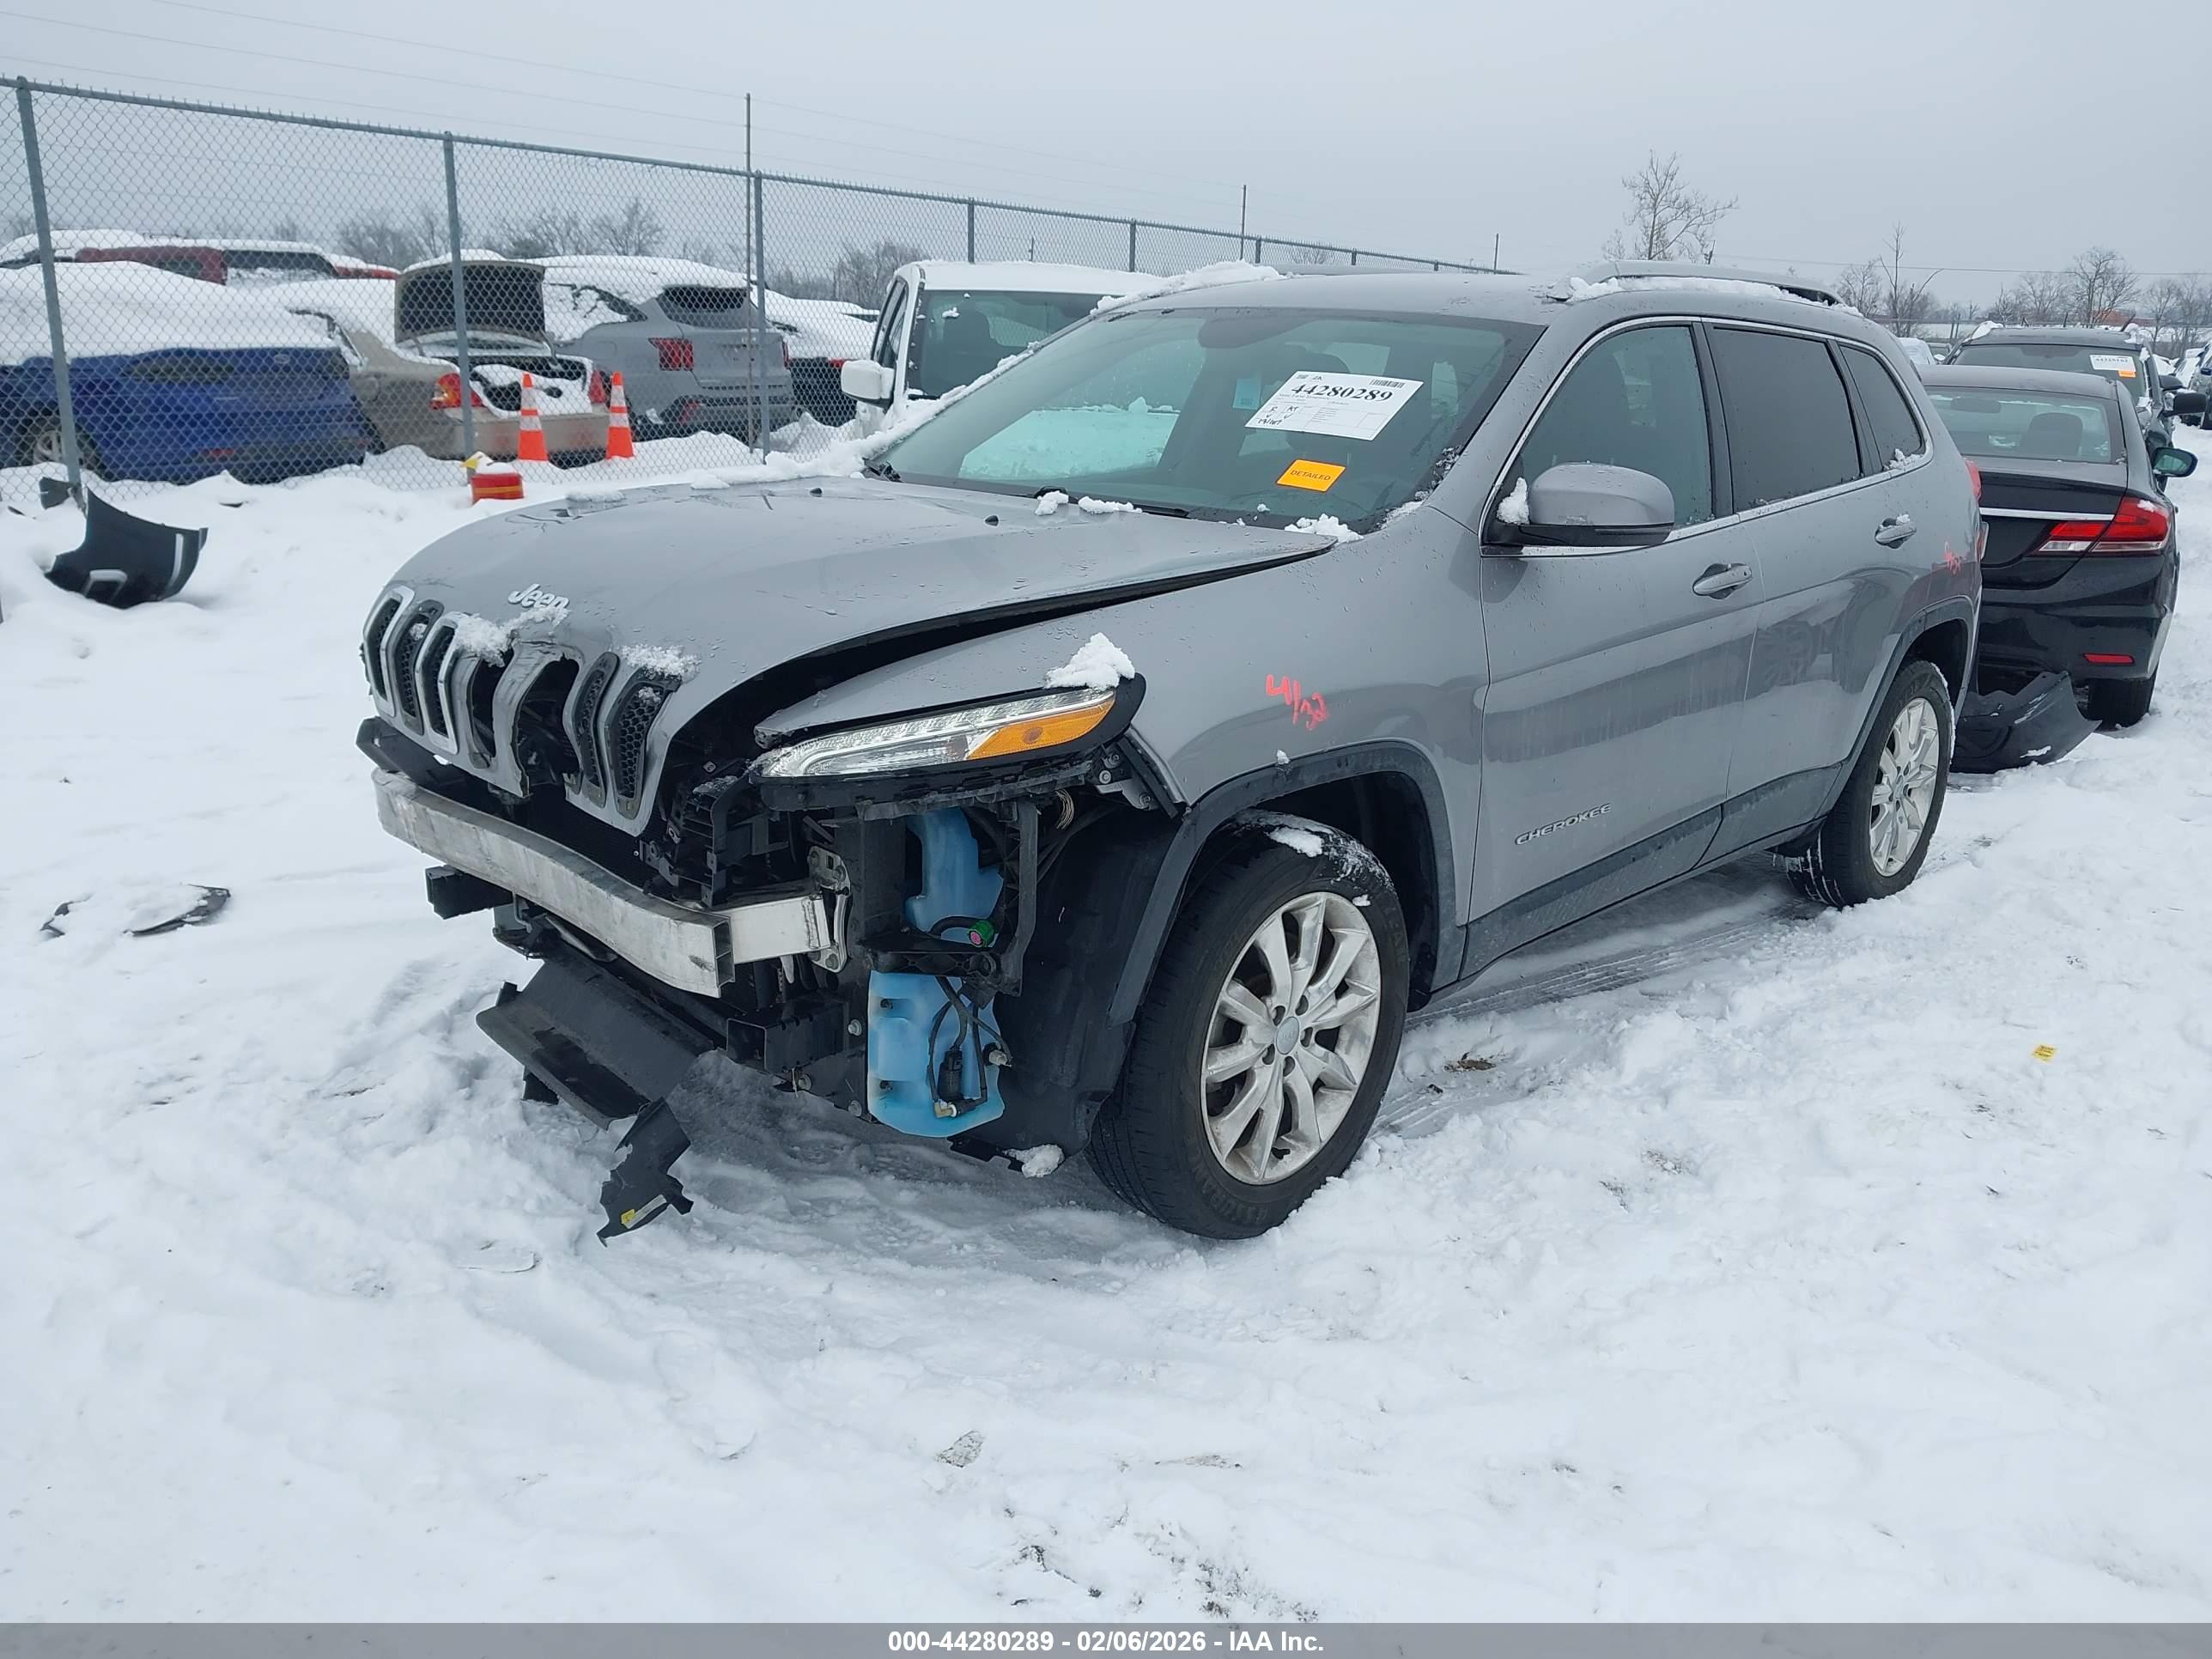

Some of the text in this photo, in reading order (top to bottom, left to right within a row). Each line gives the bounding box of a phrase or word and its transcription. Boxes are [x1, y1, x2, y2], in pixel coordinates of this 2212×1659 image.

[1291, 384, 1393, 401] 44280289
[1290, 470, 1331, 481] DETAILED
[1514, 802, 1612, 845] CHEROKEE
